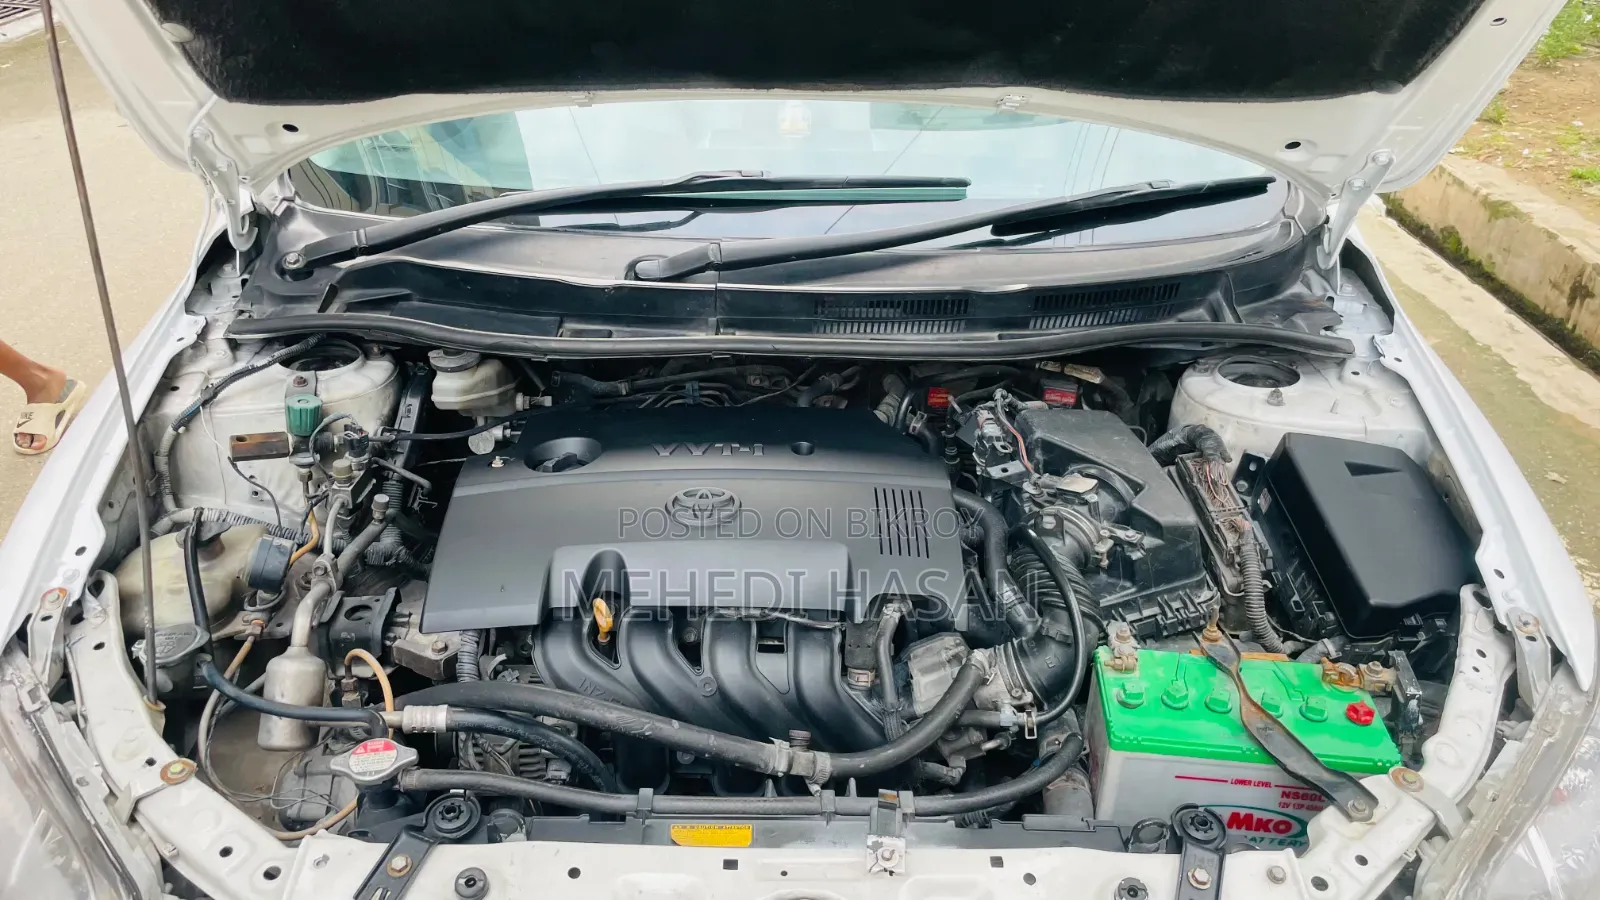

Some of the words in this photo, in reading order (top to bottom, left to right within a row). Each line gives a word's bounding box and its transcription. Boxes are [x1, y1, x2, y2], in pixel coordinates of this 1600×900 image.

[1230, 778, 1252, 787] LOWER
[1253, 780, 1272, 789] LEVEL
[1247, 836, 1306, 847] ATTERY
